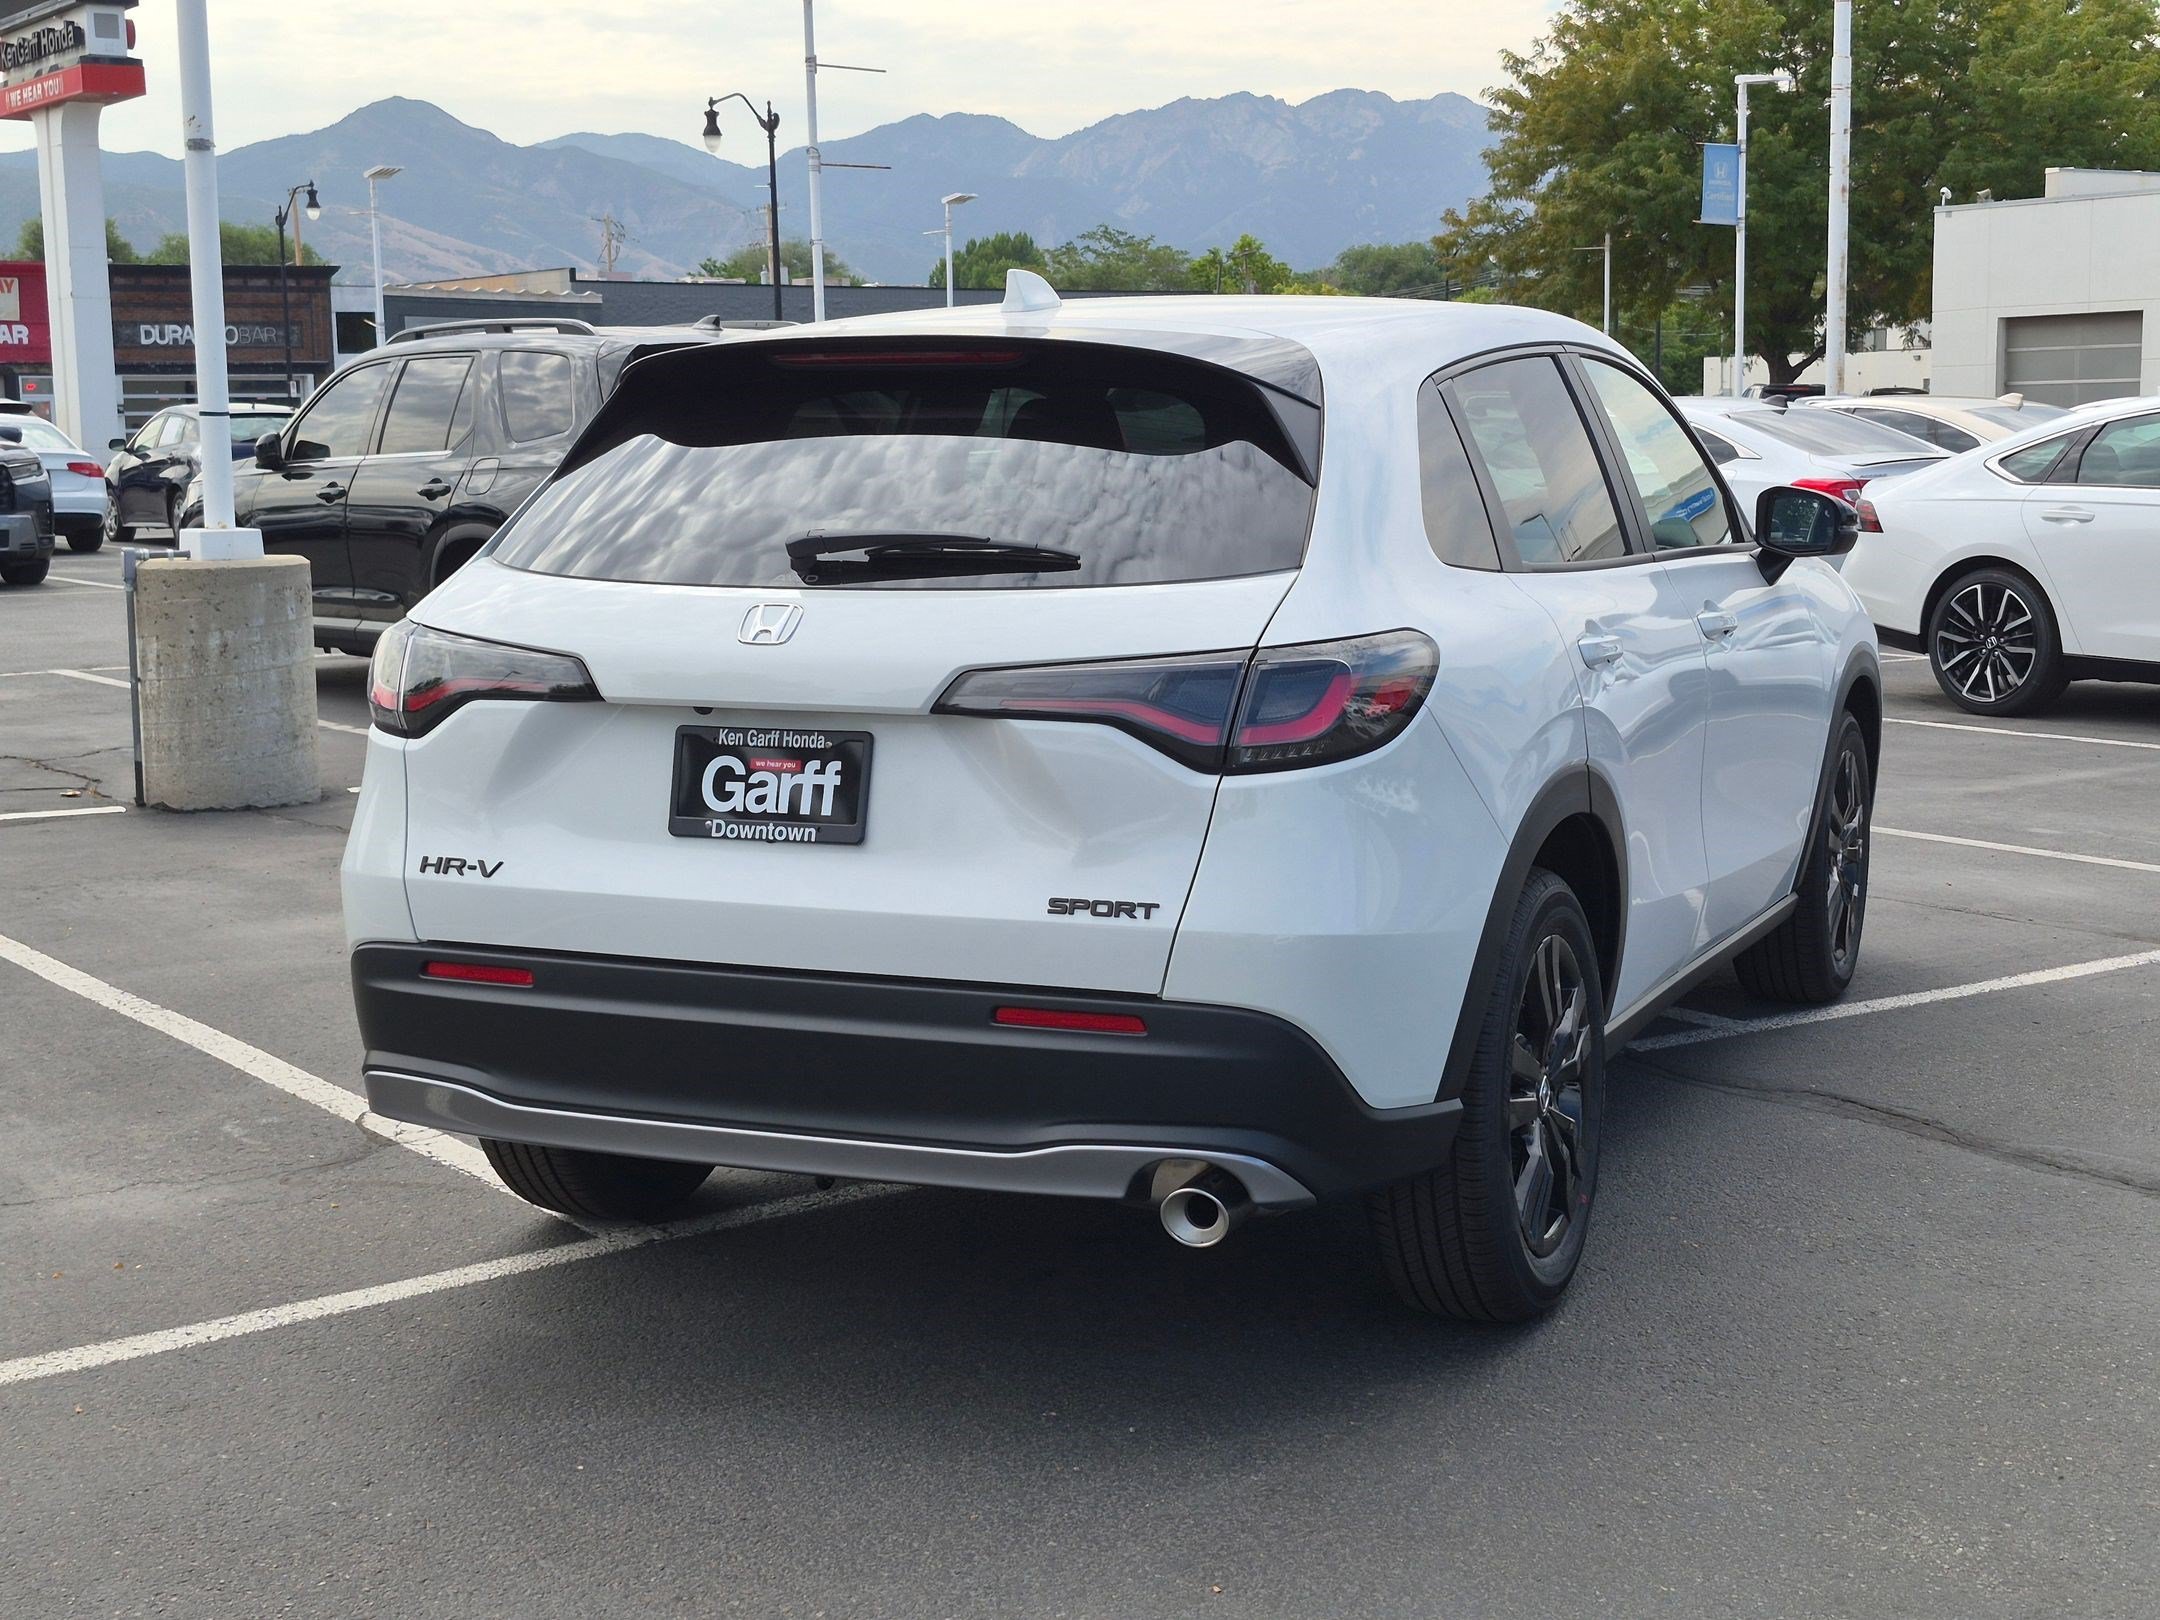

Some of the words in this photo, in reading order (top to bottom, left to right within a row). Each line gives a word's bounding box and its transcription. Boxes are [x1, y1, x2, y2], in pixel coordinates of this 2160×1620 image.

[41, 24, 74, 56] Honda
[10, 90, 21, 107] WE
[23, 83, 42, 104] HEAR
[44, 78, 60, 97] YOU
[718, 728, 743, 746] Ken
[747, 730, 779, 748] Garff
[783, 732, 825, 749] Honda
[767, 760, 782, 768] hear
[783, 761, 796, 769] you
[701, 755, 842, 816] Garff
[711, 819, 816, 842] Downtown
[419, 855, 504, 878] HR-V
[1047, 897, 1160, 920] SPORT
